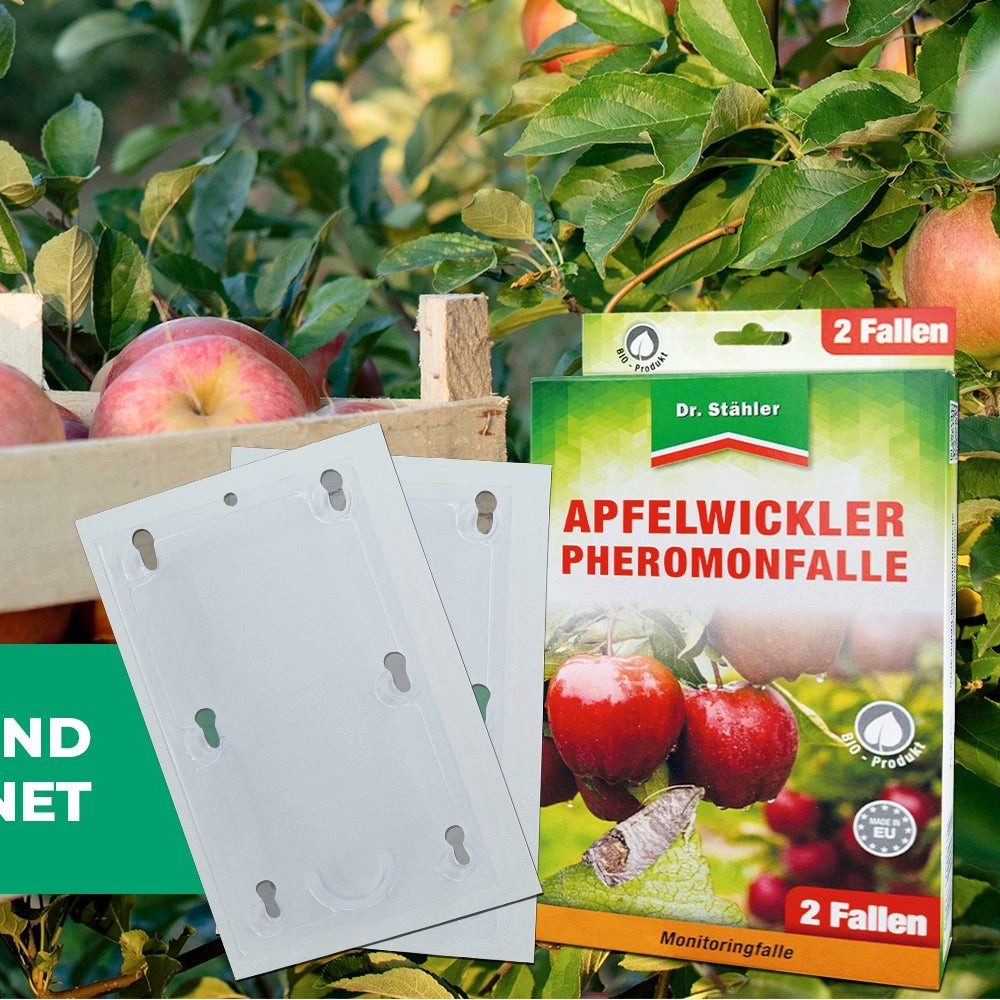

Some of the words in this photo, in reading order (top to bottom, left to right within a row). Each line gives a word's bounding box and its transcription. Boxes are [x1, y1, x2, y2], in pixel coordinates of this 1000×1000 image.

[834, 319, 851, 344] 2
[860, 318, 948, 344] Fallen
[616, 348, 629, 364] BIO
[634, 352, 668, 372] Produkt
[676, 402, 702, 418] Dr.
[708, 402, 781, 417] Stähler
[563, 499, 904, 537] APFELWICKLER
[562, 545, 908, 582] PHEROMONFALLE
[841, 732, 861, 755] BIO
[871, 741, 926, 769] Produkt
[869, 817, 891, 826] MADE
[873, 827, 897, 839] EU
[799, 900, 820, 926] 2
[830, 902, 928, 936] Fallen
[660, 930, 794, 960] Monitoringfalle
